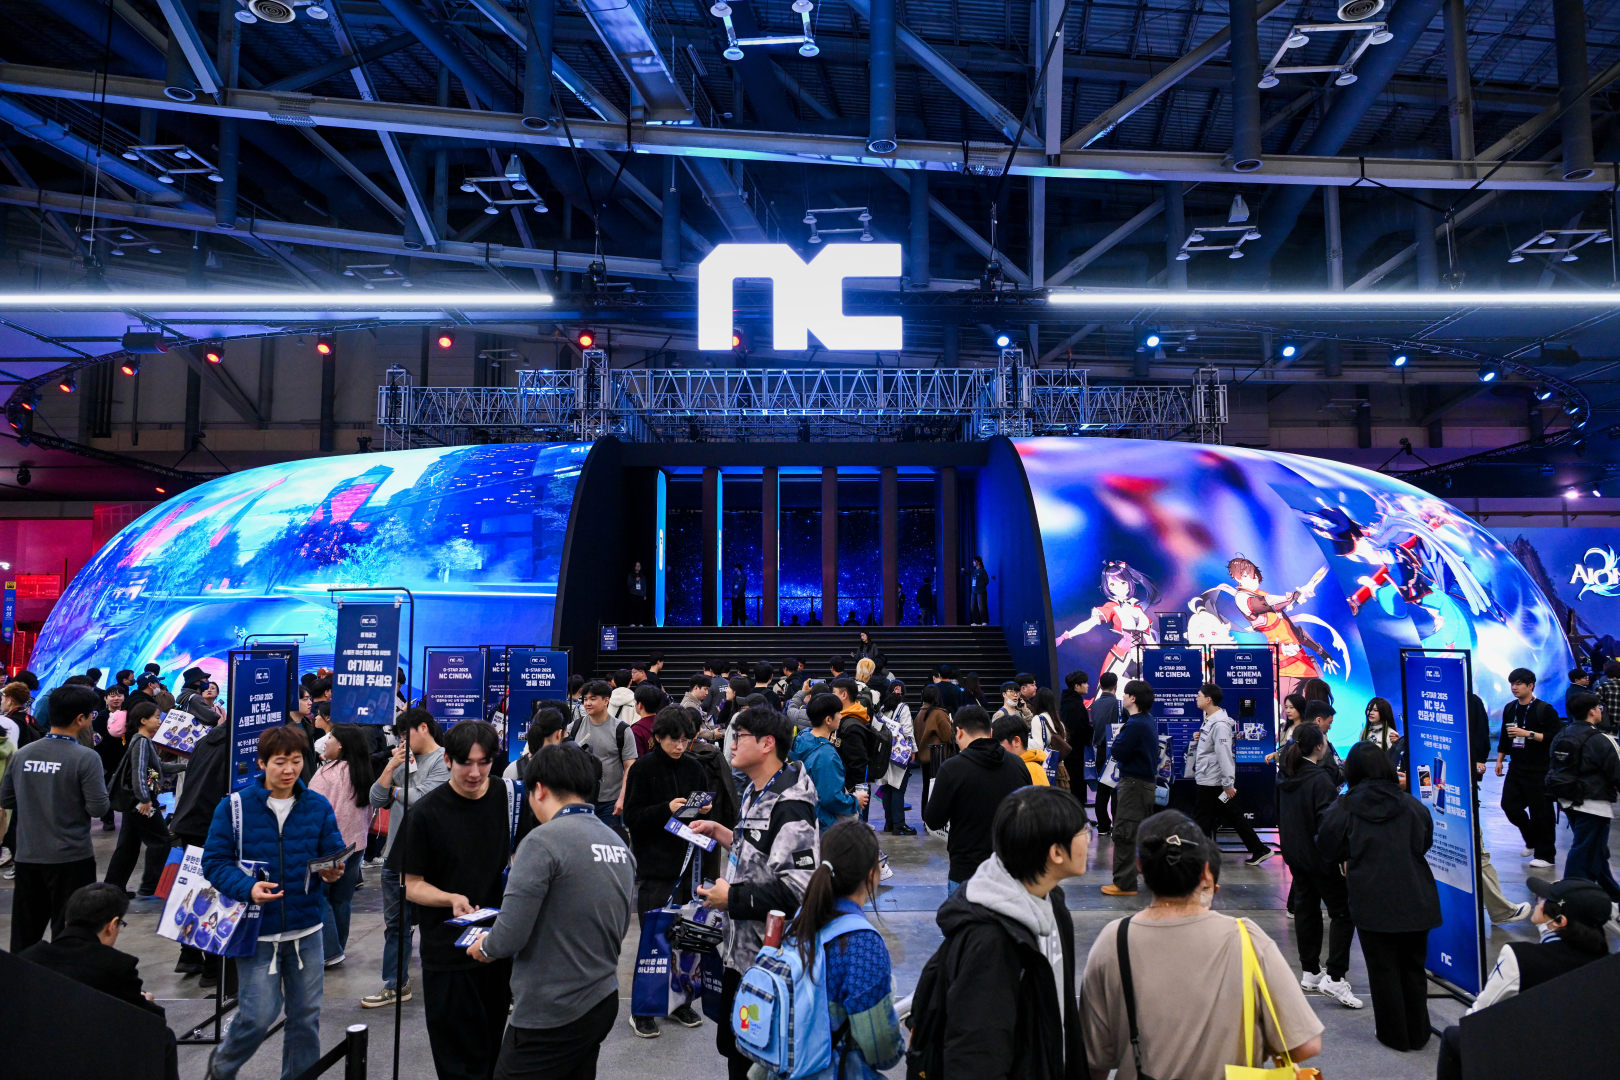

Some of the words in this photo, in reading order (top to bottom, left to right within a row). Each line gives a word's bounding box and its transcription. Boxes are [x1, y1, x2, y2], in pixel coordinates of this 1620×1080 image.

[348, 660, 383, 672] 여기에서
[337, 674, 364, 686] 대기해
[366, 674, 392, 687] 주세요
[251, 702, 260, 714] NC
[261, 702, 271, 712] 부스
[1424, 700, 1433, 710] NC
[1434, 701, 1446, 712] 부스
[238, 715, 255, 727] 스탬프
[256, 713, 266, 724] 미션
[267, 711, 282, 723] 이벤트
[1418, 710, 1435, 722] 인증샷
[1436, 712, 1454, 725] 이벤트
[24, 760, 62, 774] STAFF
[591, 844, 628, 864] STAFF
